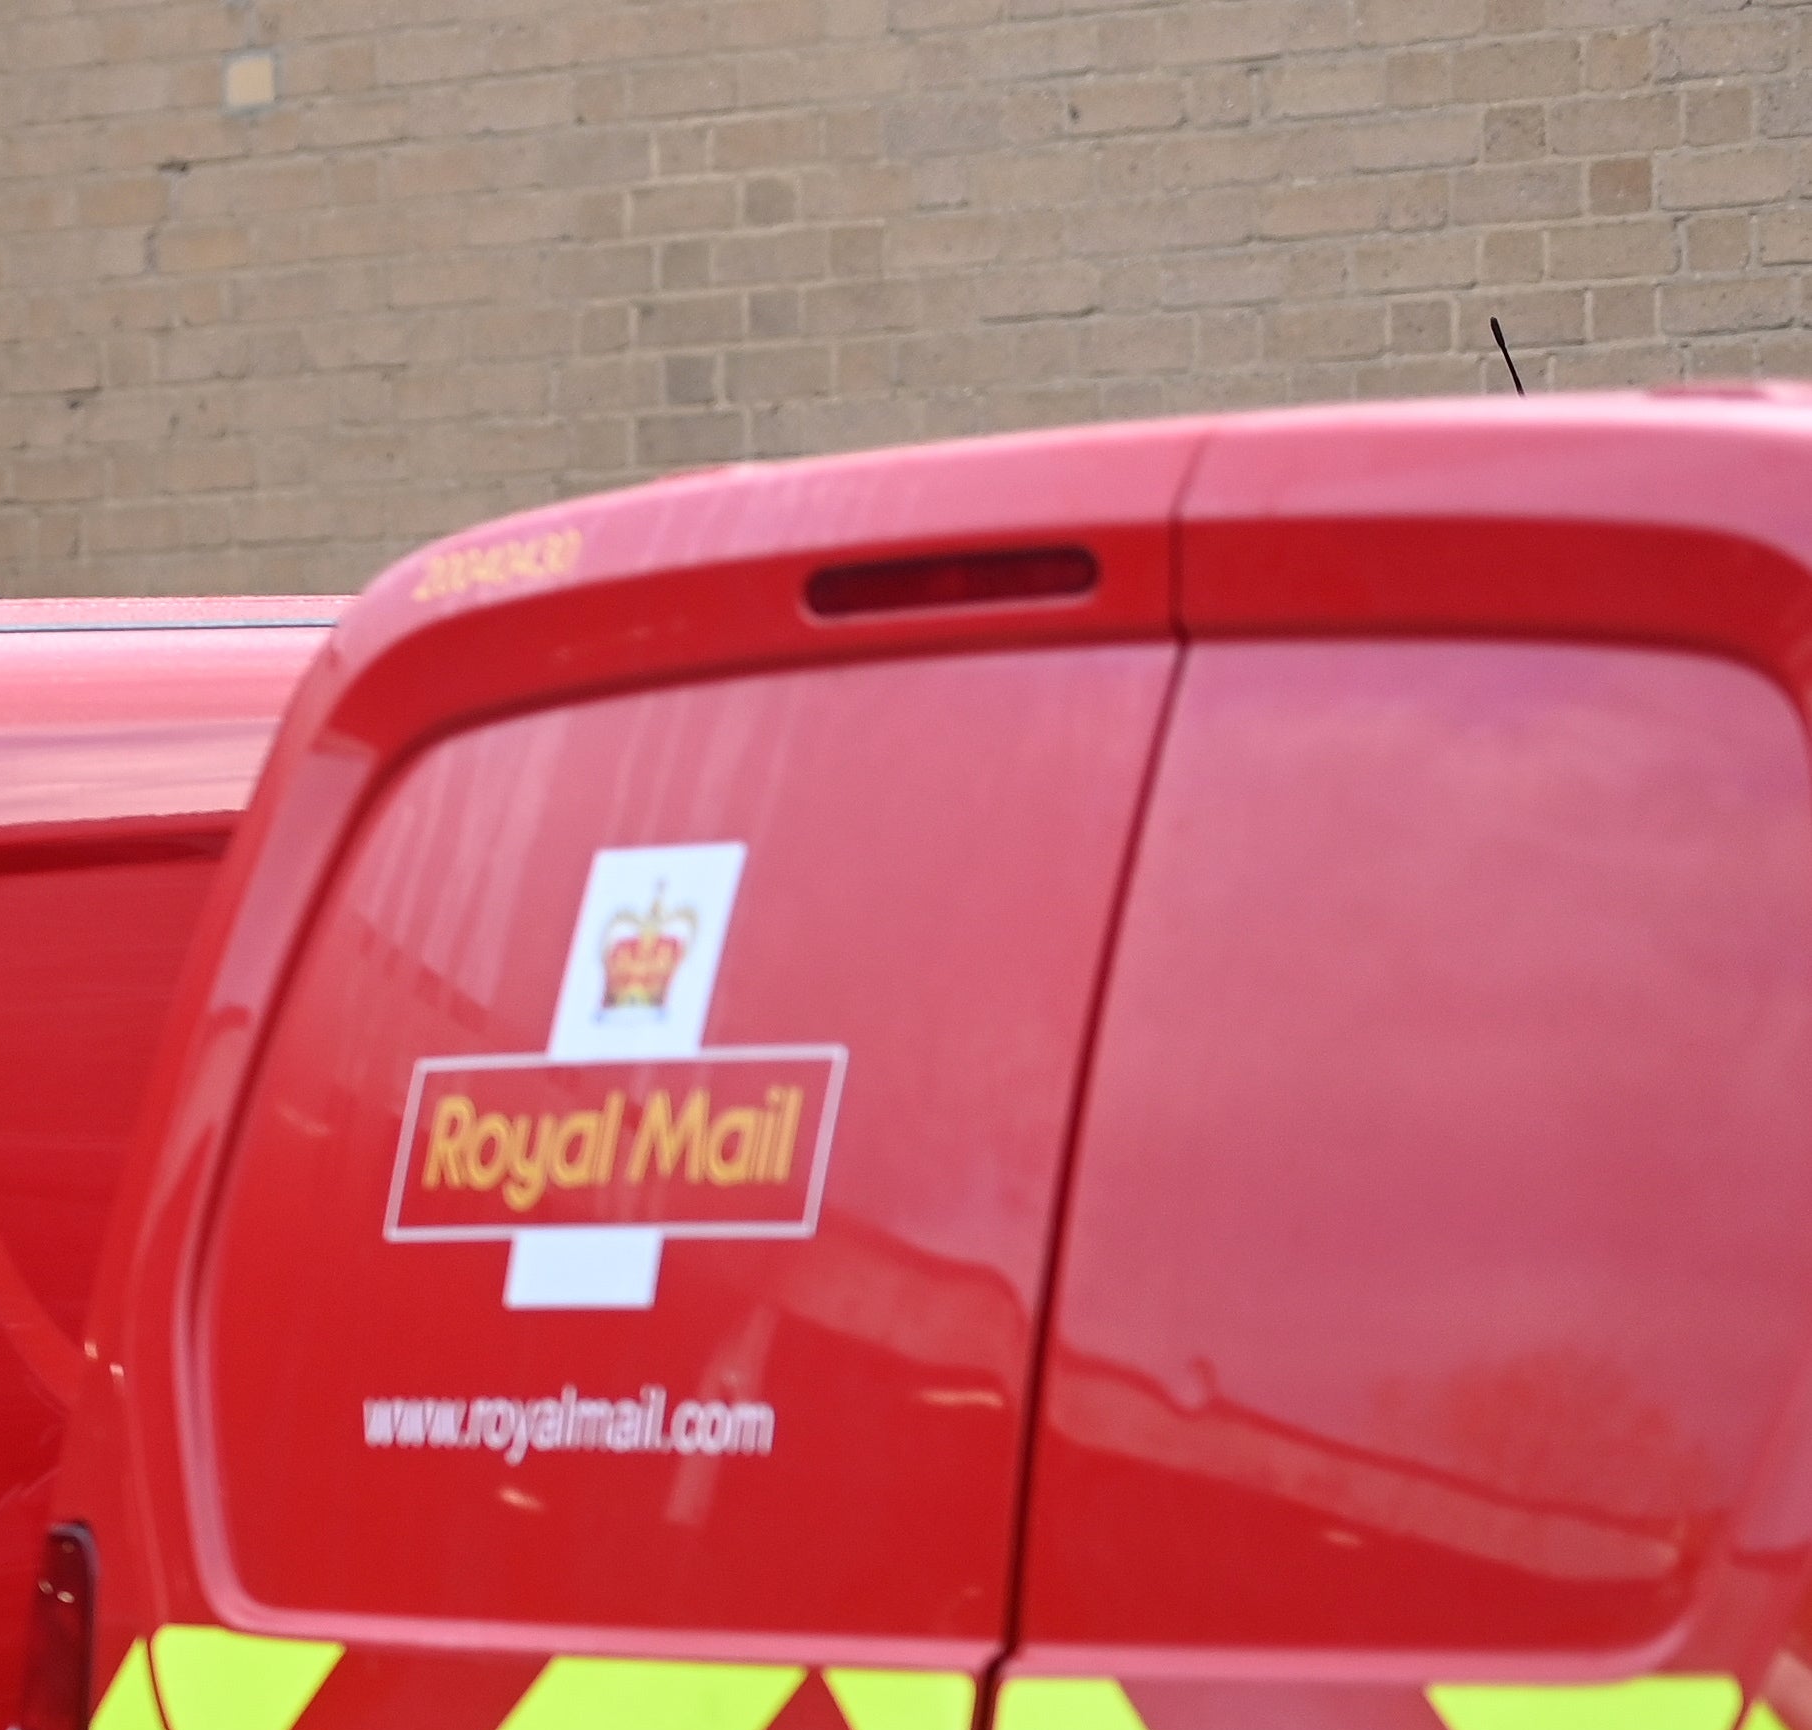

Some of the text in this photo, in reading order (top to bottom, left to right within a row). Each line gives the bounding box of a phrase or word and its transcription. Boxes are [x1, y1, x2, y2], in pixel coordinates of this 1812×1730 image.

[421, 1085, 804, 1212] Royal Mail
[362, 1383, 776, 1466] www.royalmail.com
